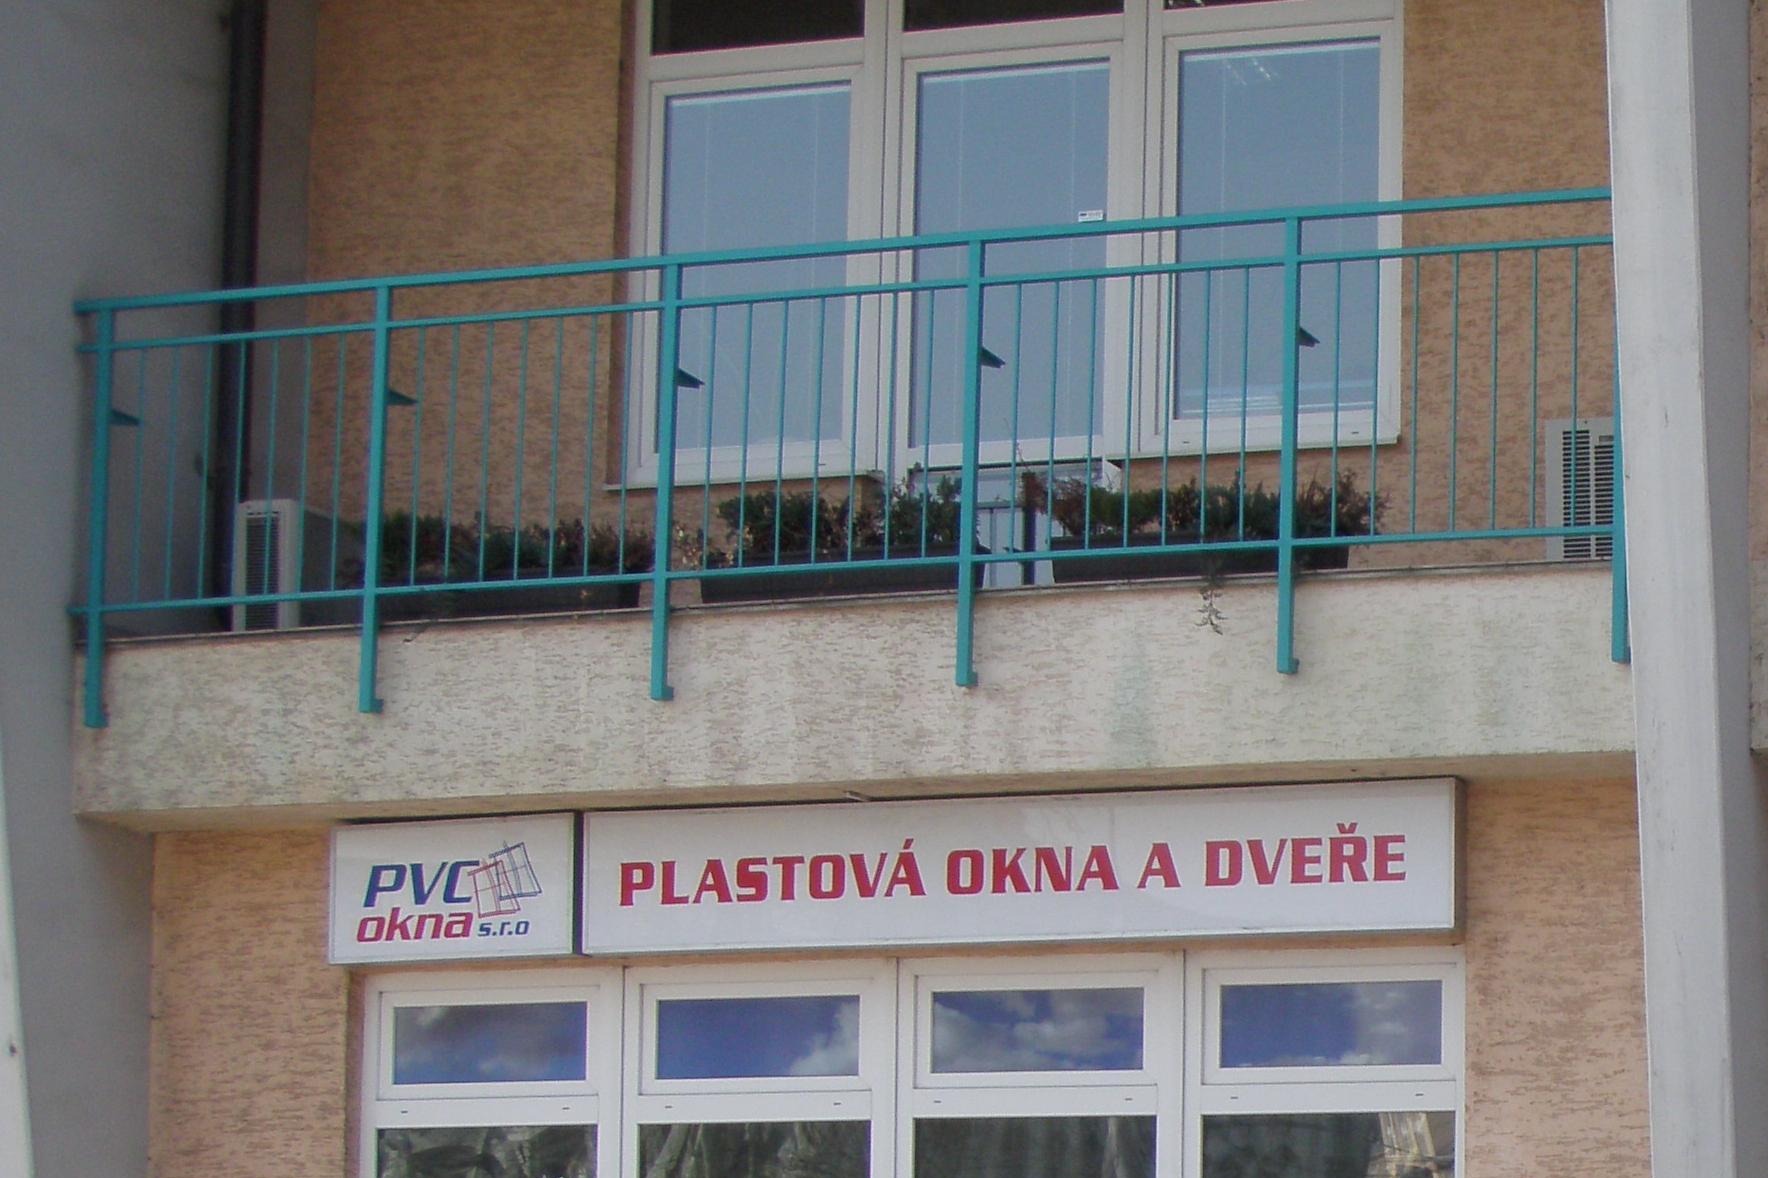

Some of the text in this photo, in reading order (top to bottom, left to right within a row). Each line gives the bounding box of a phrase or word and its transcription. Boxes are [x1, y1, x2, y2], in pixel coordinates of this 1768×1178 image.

[363, 860, 480, 908] PVC
[619, 822, 1406, 907] PLASTOVÁ OKNA A DVEŘE
[357, 907, 529, 943] okna s.r.o
